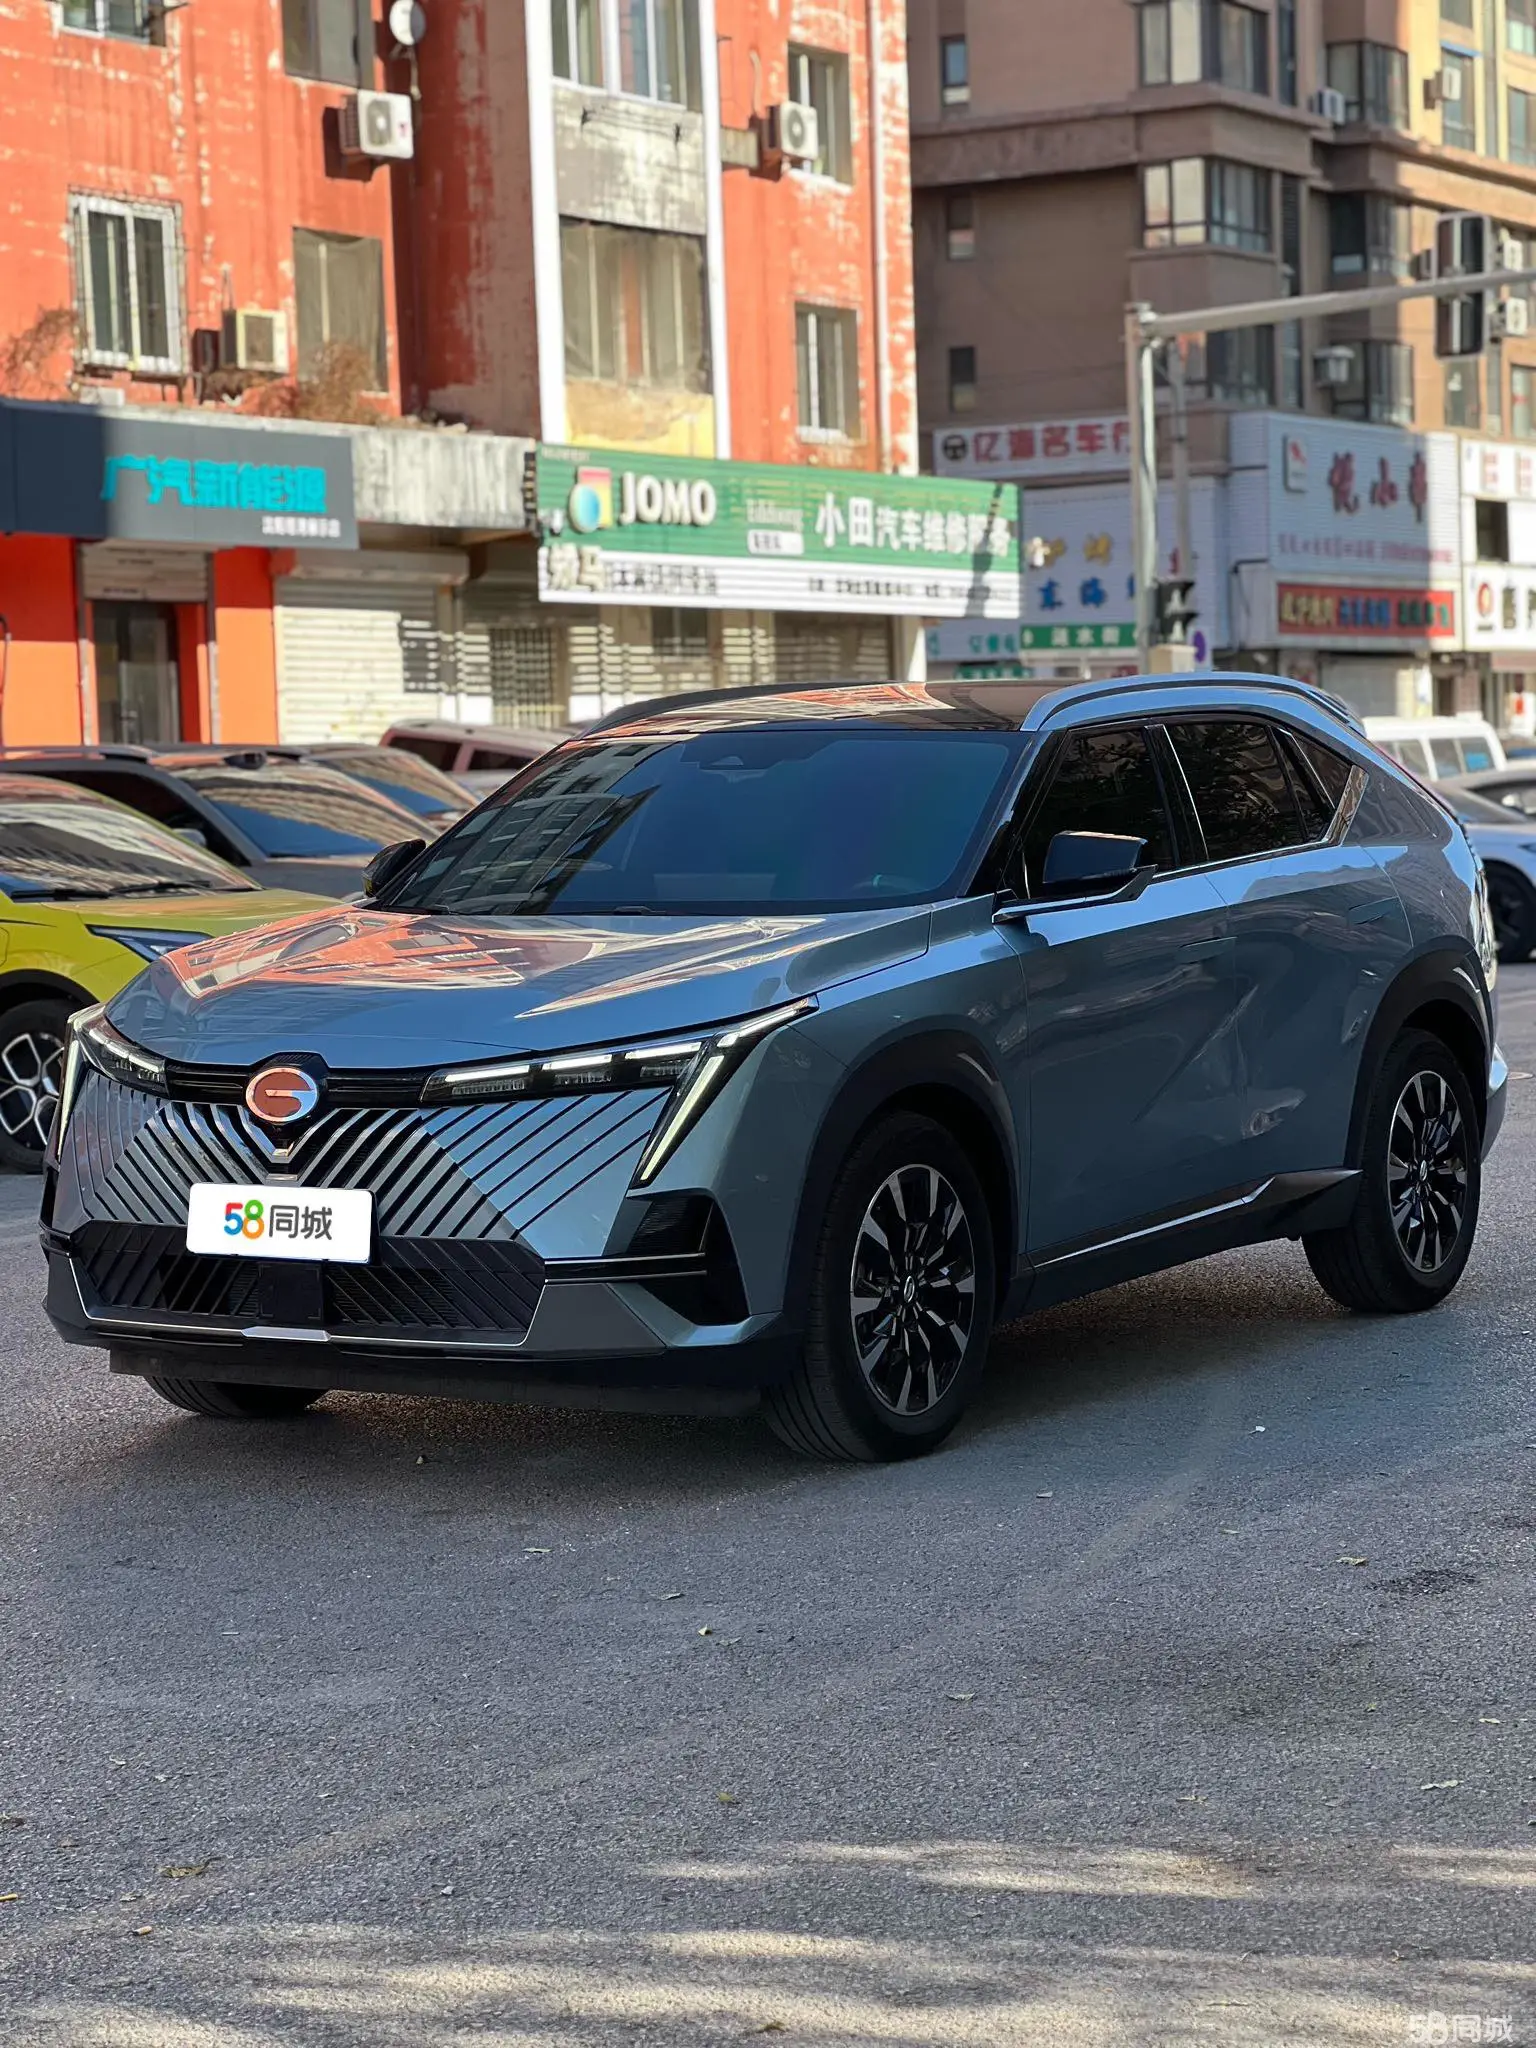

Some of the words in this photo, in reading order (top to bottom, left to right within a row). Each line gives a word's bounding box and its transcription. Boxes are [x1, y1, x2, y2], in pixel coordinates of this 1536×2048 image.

[100, 453, 327, 514] 广汽新能源
[618, 471, 717, 527] JOMO
